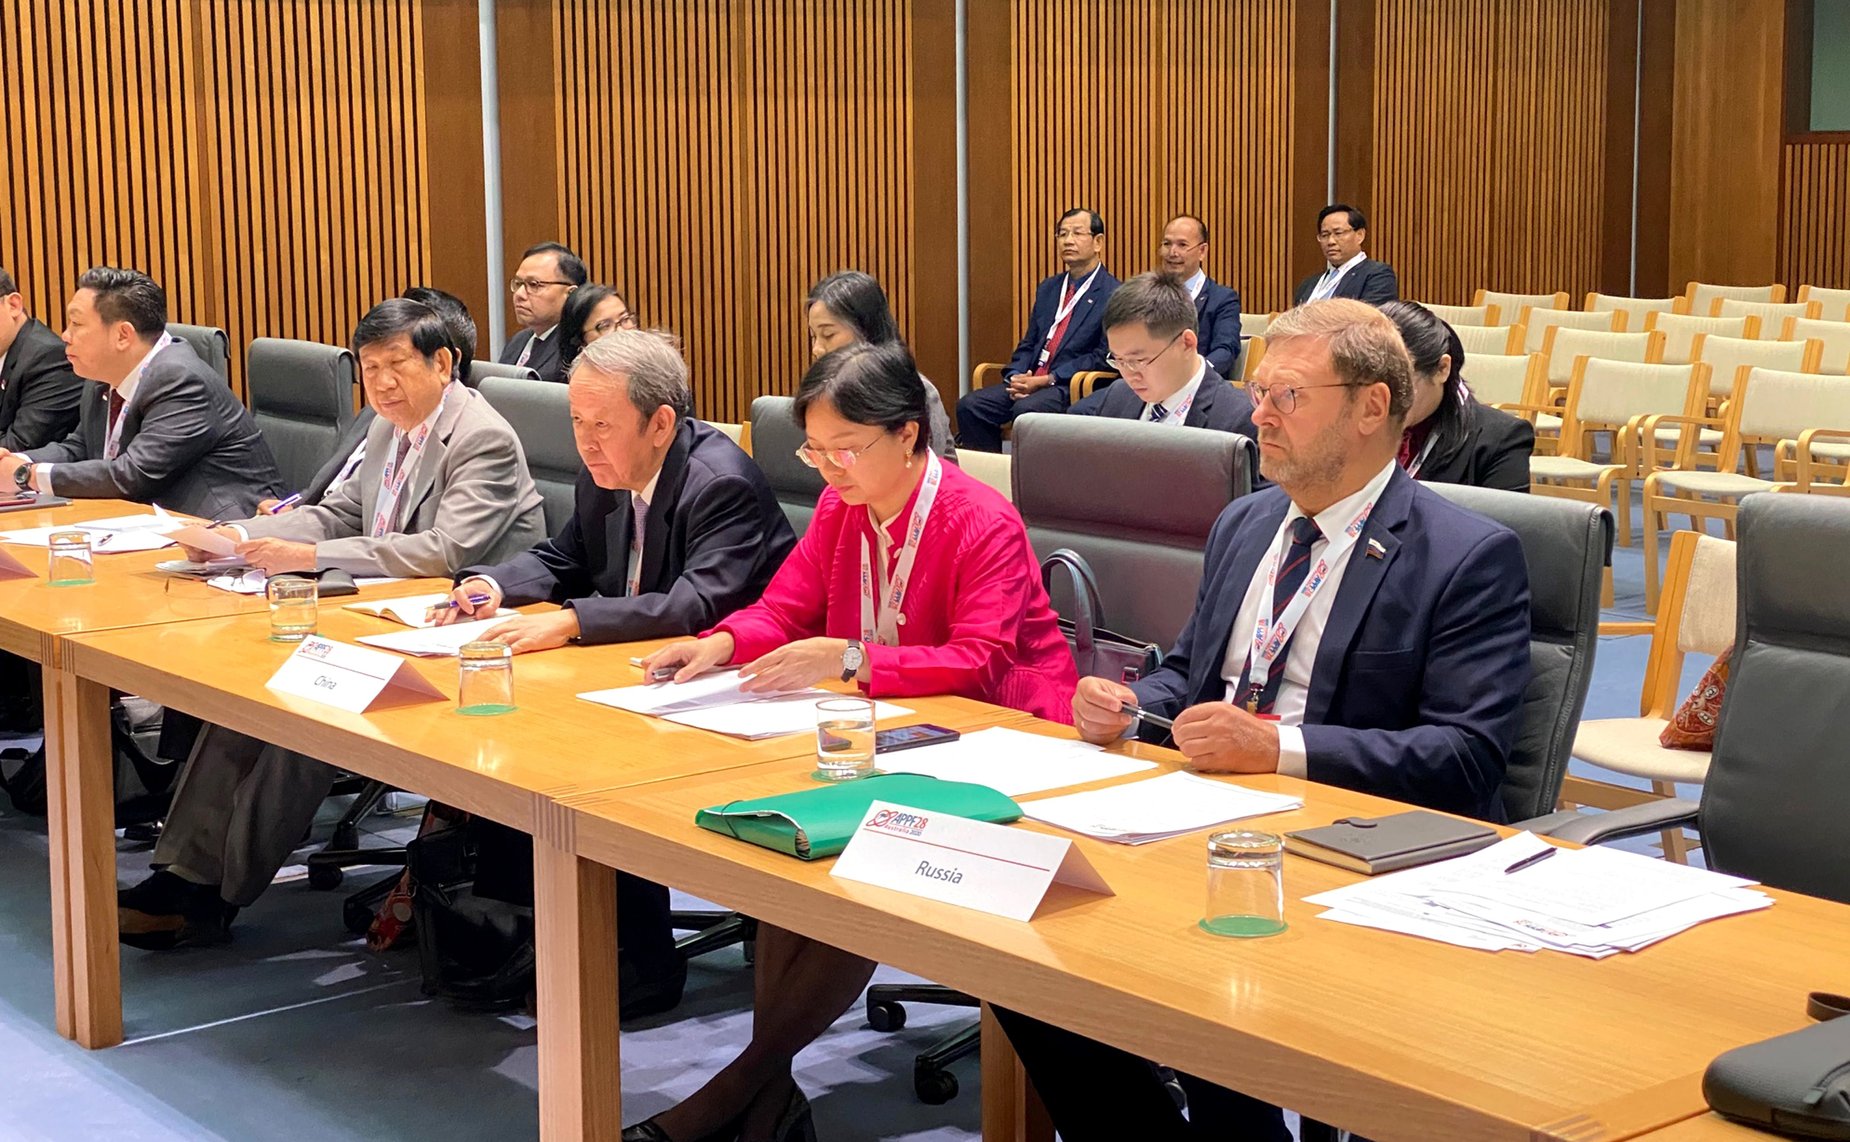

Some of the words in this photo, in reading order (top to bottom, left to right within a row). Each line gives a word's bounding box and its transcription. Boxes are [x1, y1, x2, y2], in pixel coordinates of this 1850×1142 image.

[314, 675, 337, 691] China
[890, 812, 929, 830] APPF28
[914, 860, 963, 885] Russia
